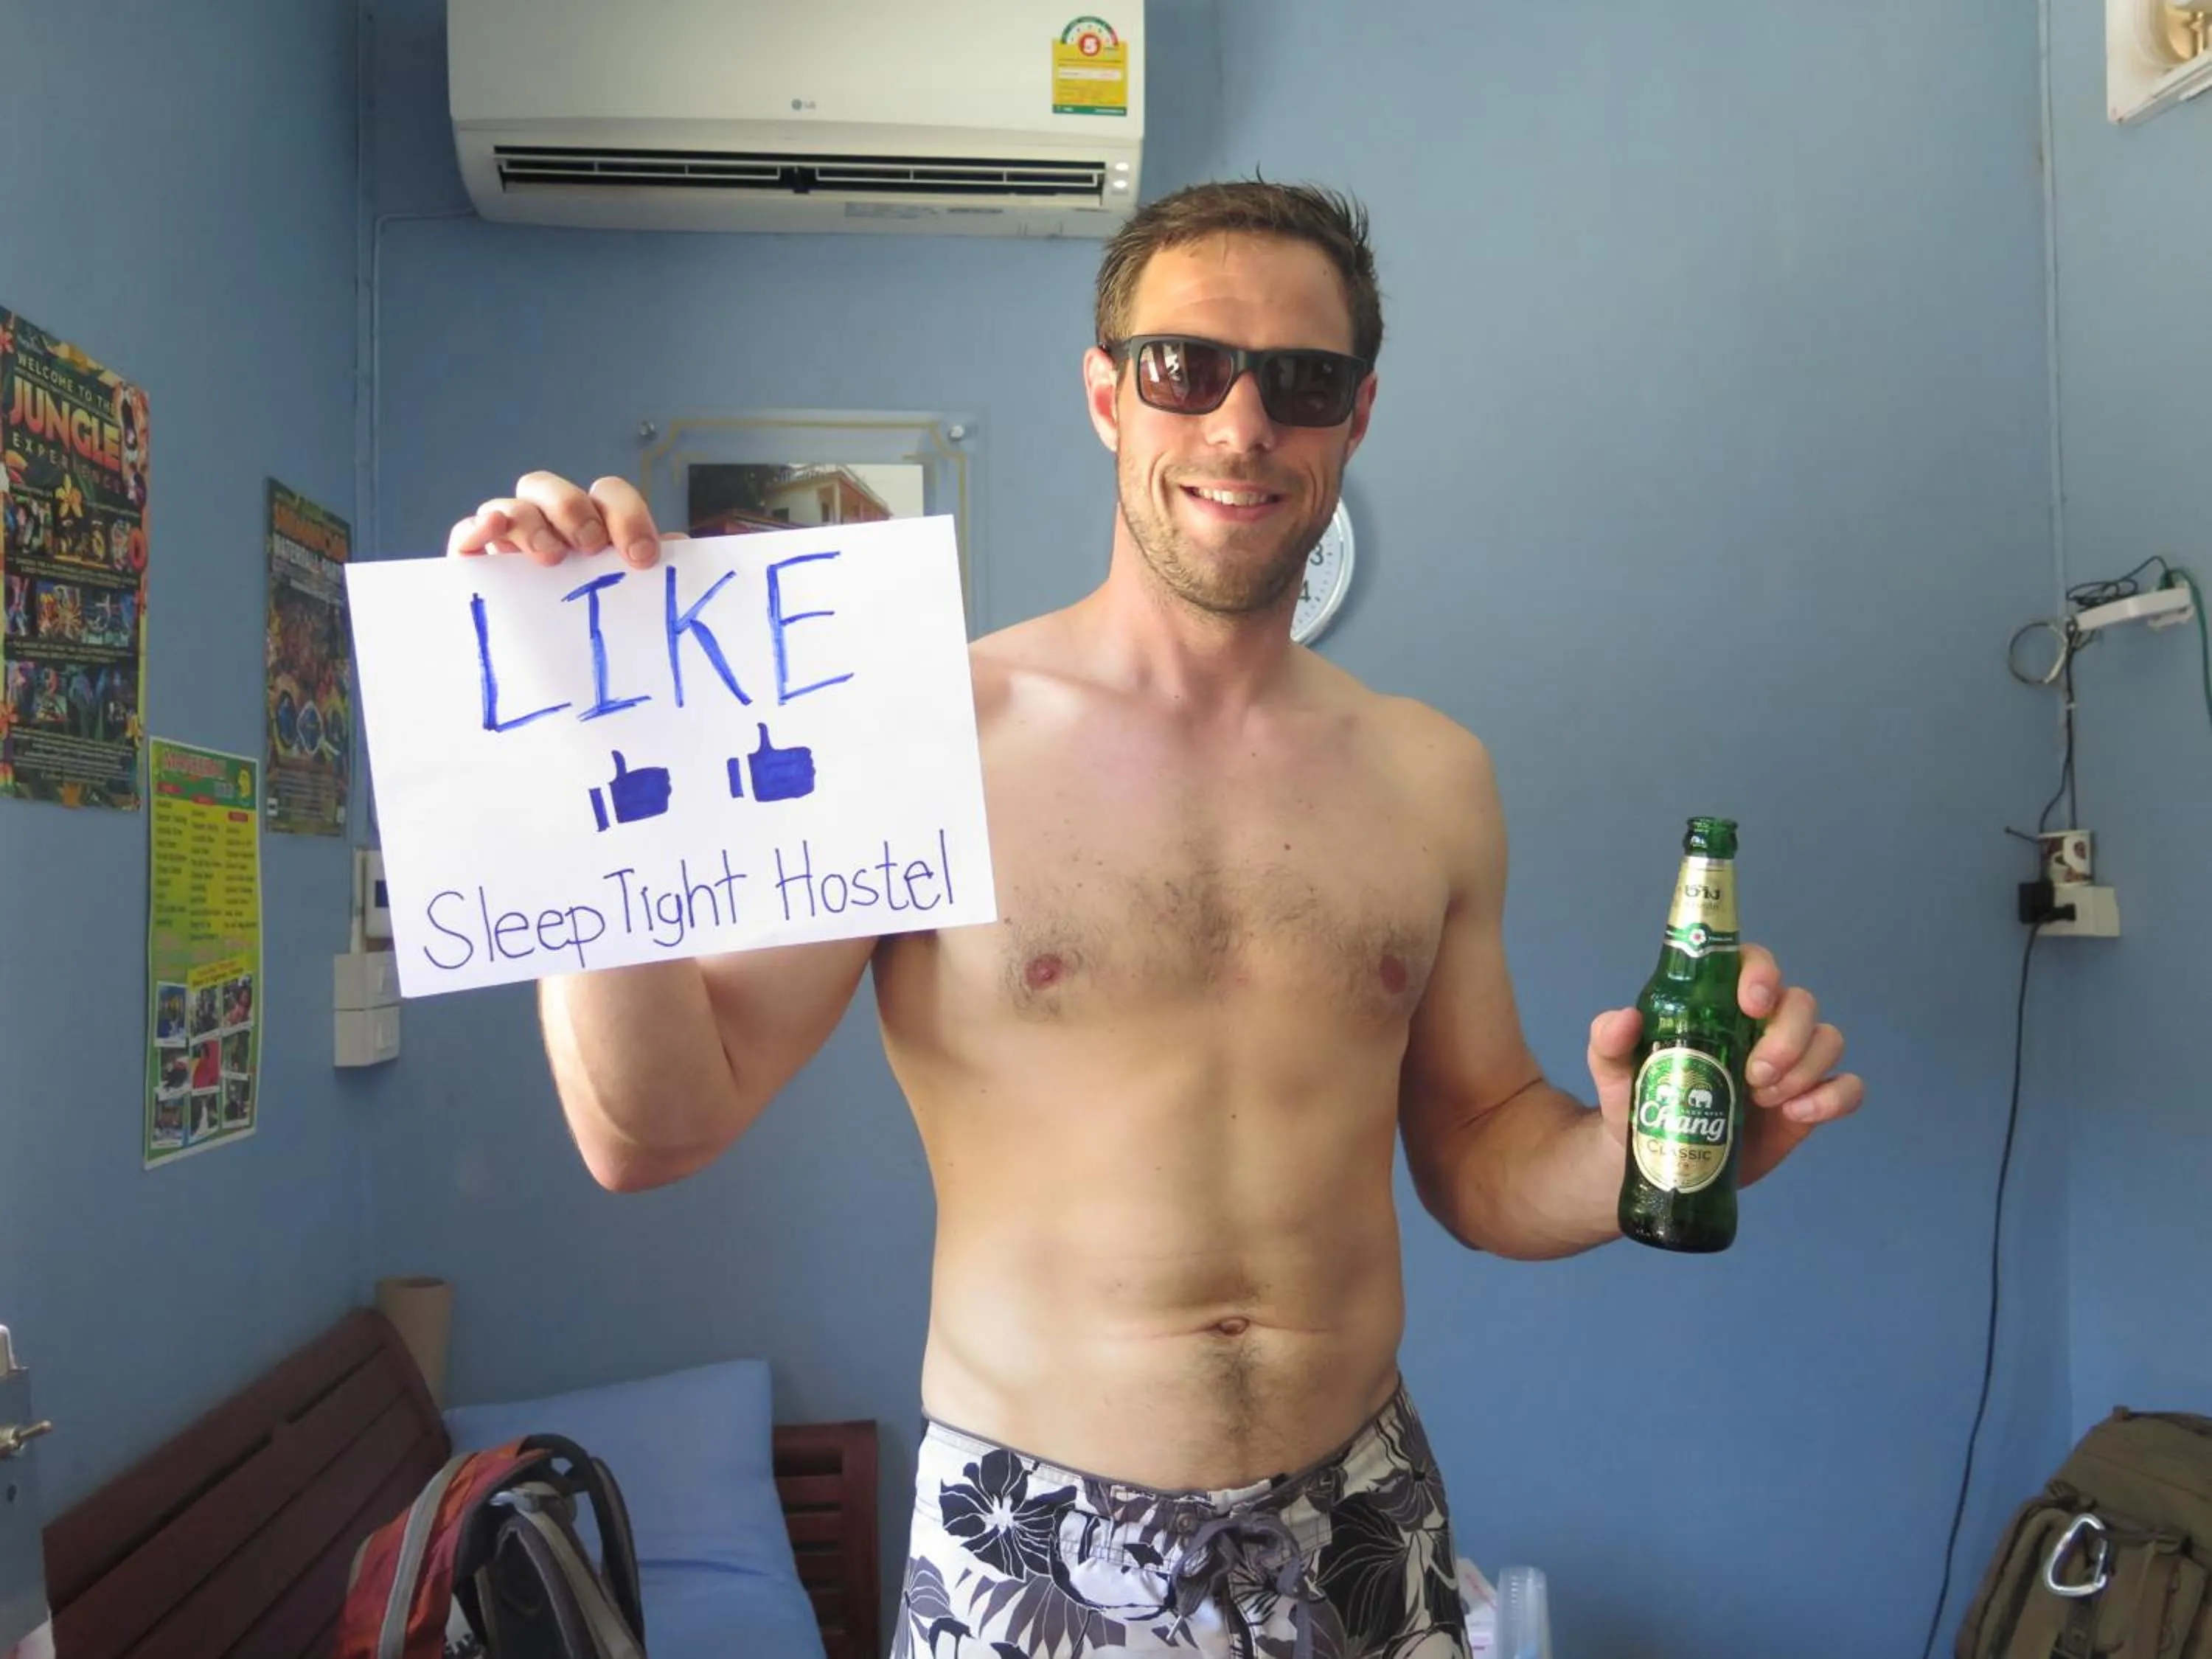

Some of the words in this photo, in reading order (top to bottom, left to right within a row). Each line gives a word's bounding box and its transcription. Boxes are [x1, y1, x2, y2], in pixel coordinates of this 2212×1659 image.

[17, 352, 74, 393] WELCOME
[78, 385, 93, 403] TO
[10, 375, 122, 471] JUNGLE
[1310, 543, 1324, 566] 3
[471, 552, 854, 732] LIKE
[775, 830, 954, 922] Hostel
[1640, 1100, 1727, 1142] Chang
